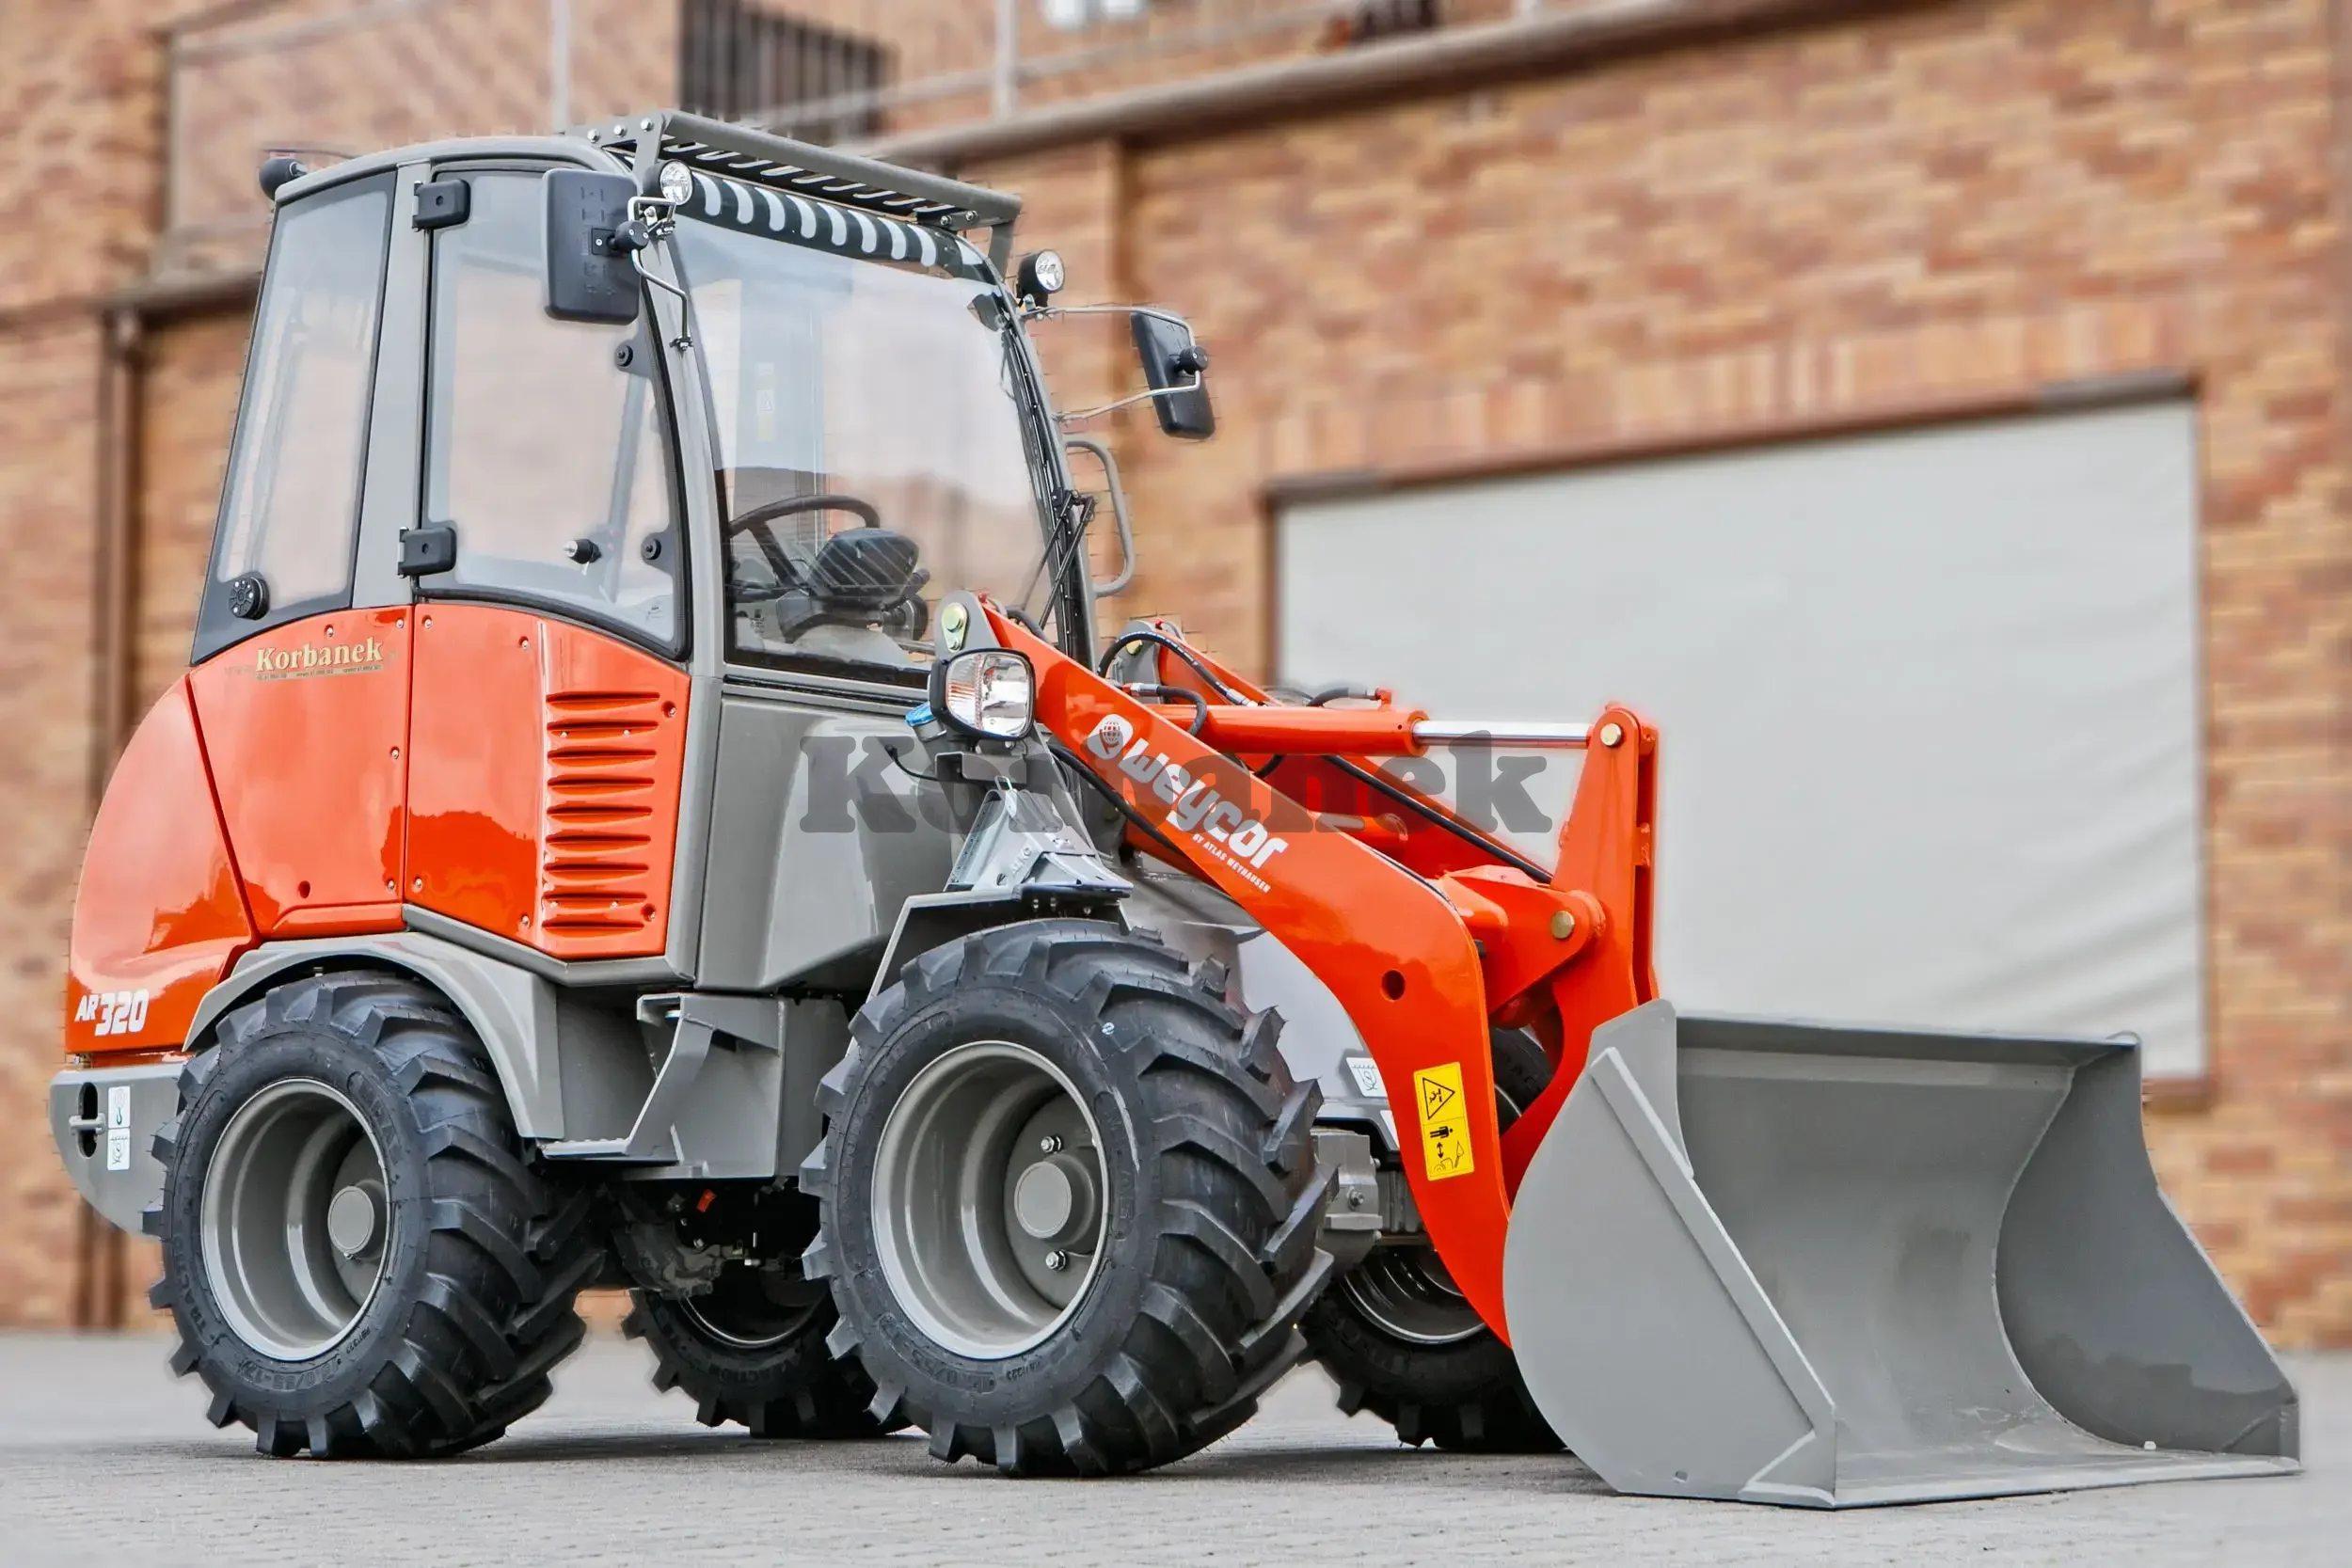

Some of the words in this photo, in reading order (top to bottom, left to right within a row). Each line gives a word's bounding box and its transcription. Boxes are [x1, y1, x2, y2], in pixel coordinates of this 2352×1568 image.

[255, 636, 384, 672] Korbanek
[1118, 737, 1290, 869] weycor
[1202, 841, 1228, 861] ATLAS
